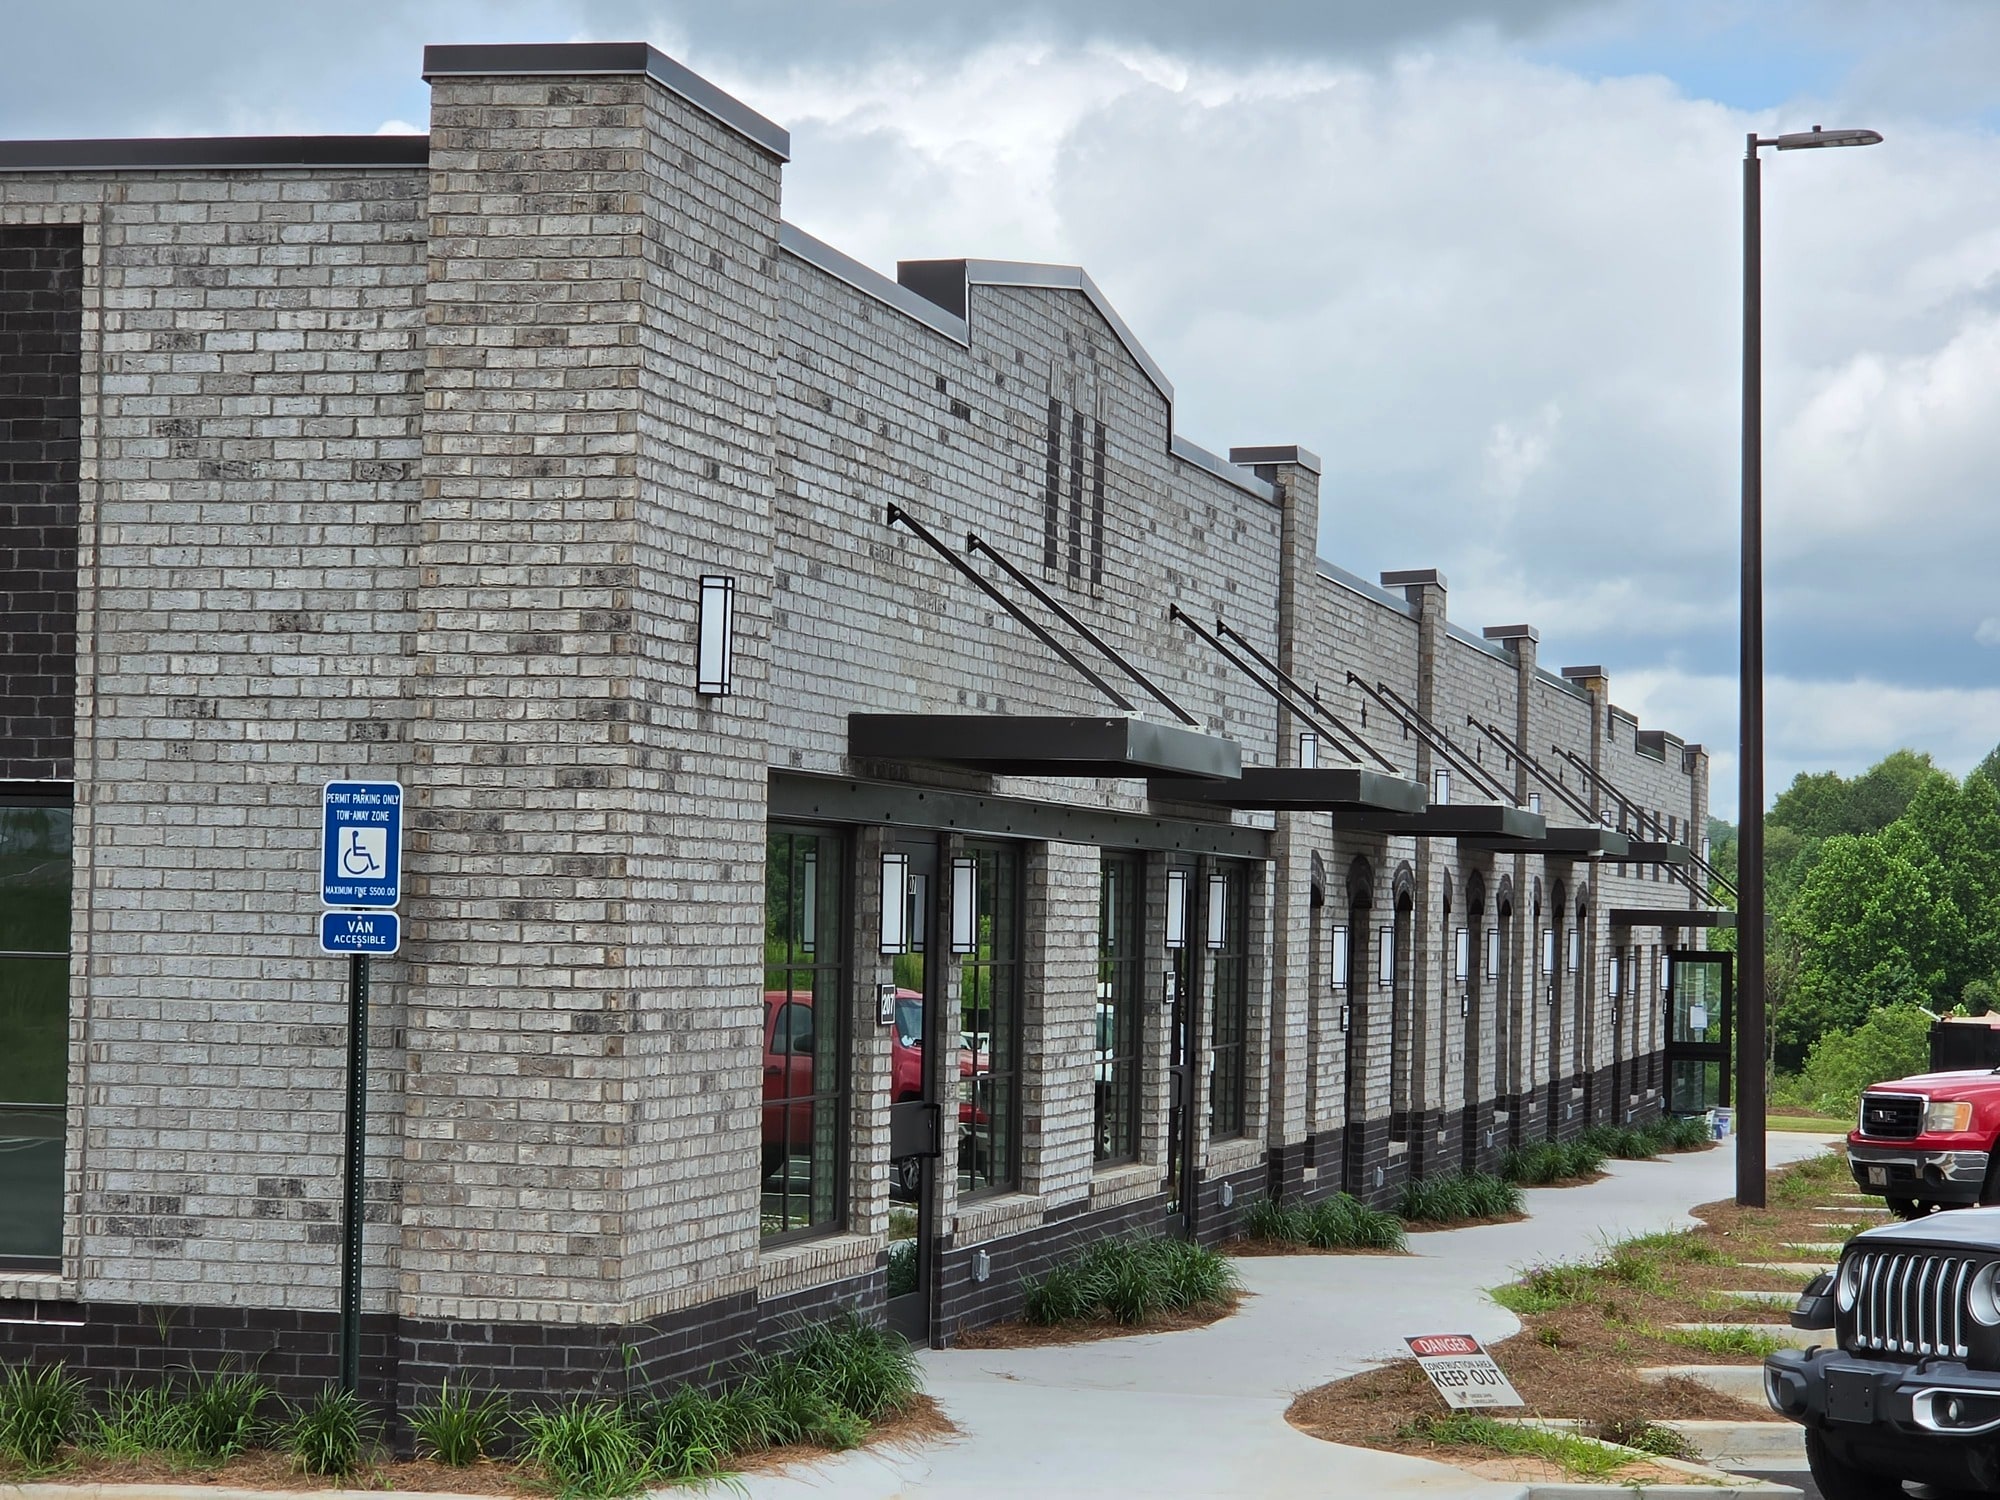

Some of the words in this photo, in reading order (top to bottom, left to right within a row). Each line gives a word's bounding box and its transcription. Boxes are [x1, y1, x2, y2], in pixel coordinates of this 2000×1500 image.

[327, 793, 351, 804] PERMIT
[353, 793, 381, 805] PARKING
[382, 794, 400, 805] ONLY
[336, 809, 370, 821] TOW-AWAY
[371, 810, 390, 822] ZONE
[325, 885, 353, 895] MAXIMUM
[354, 886, 368, 896] FINE
[347, 920, 374, 934] VAN
[333, 934, 387, 945] ACCESSIBLE
[882, 993, 895, 1015] 207
[1418, 1338, 1471, 1353] DANGER
[1423, 1360, 1475, 1371] CONSTRUCTION
[1473, 1360, 1494, 1369] AREA
[1430, 1369, 1469, 1387] KEEP
[1469, 1368, 1505, 1386] OUT
